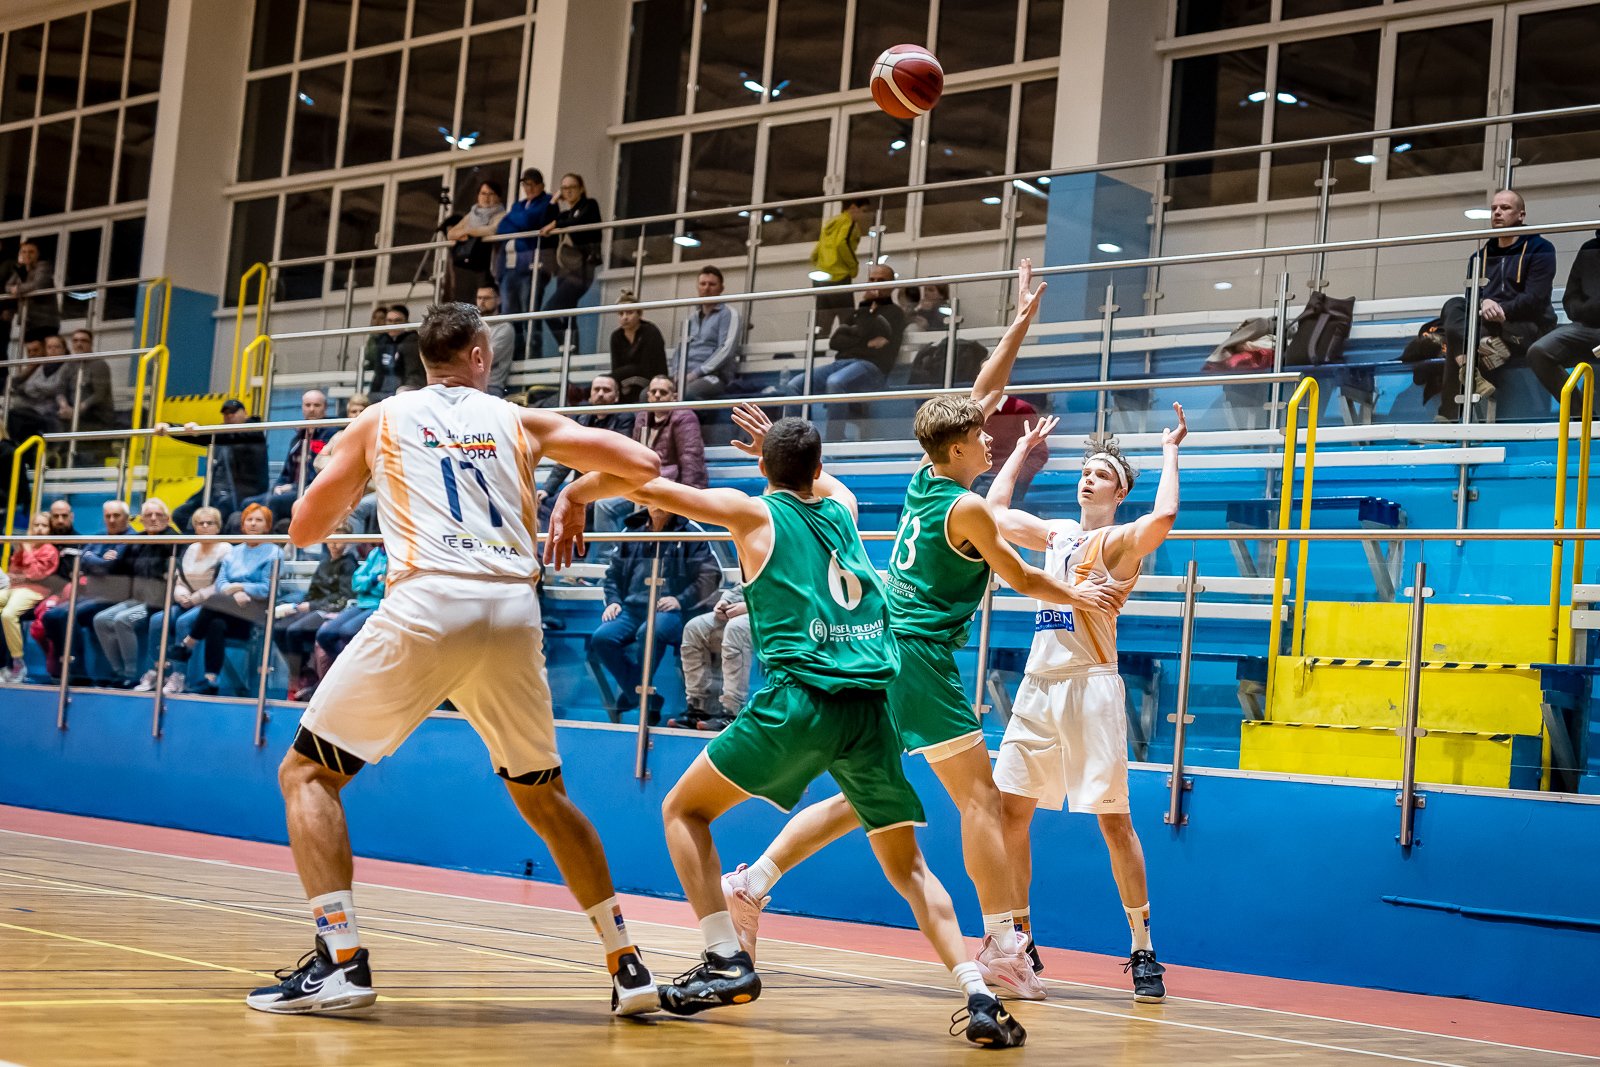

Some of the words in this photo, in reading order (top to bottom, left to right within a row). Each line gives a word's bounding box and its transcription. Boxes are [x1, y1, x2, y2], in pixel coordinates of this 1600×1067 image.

[440, 456, 503, 528] 17
[890, 510, 921, 571] 13
[827, 548, 863, 611] 6
